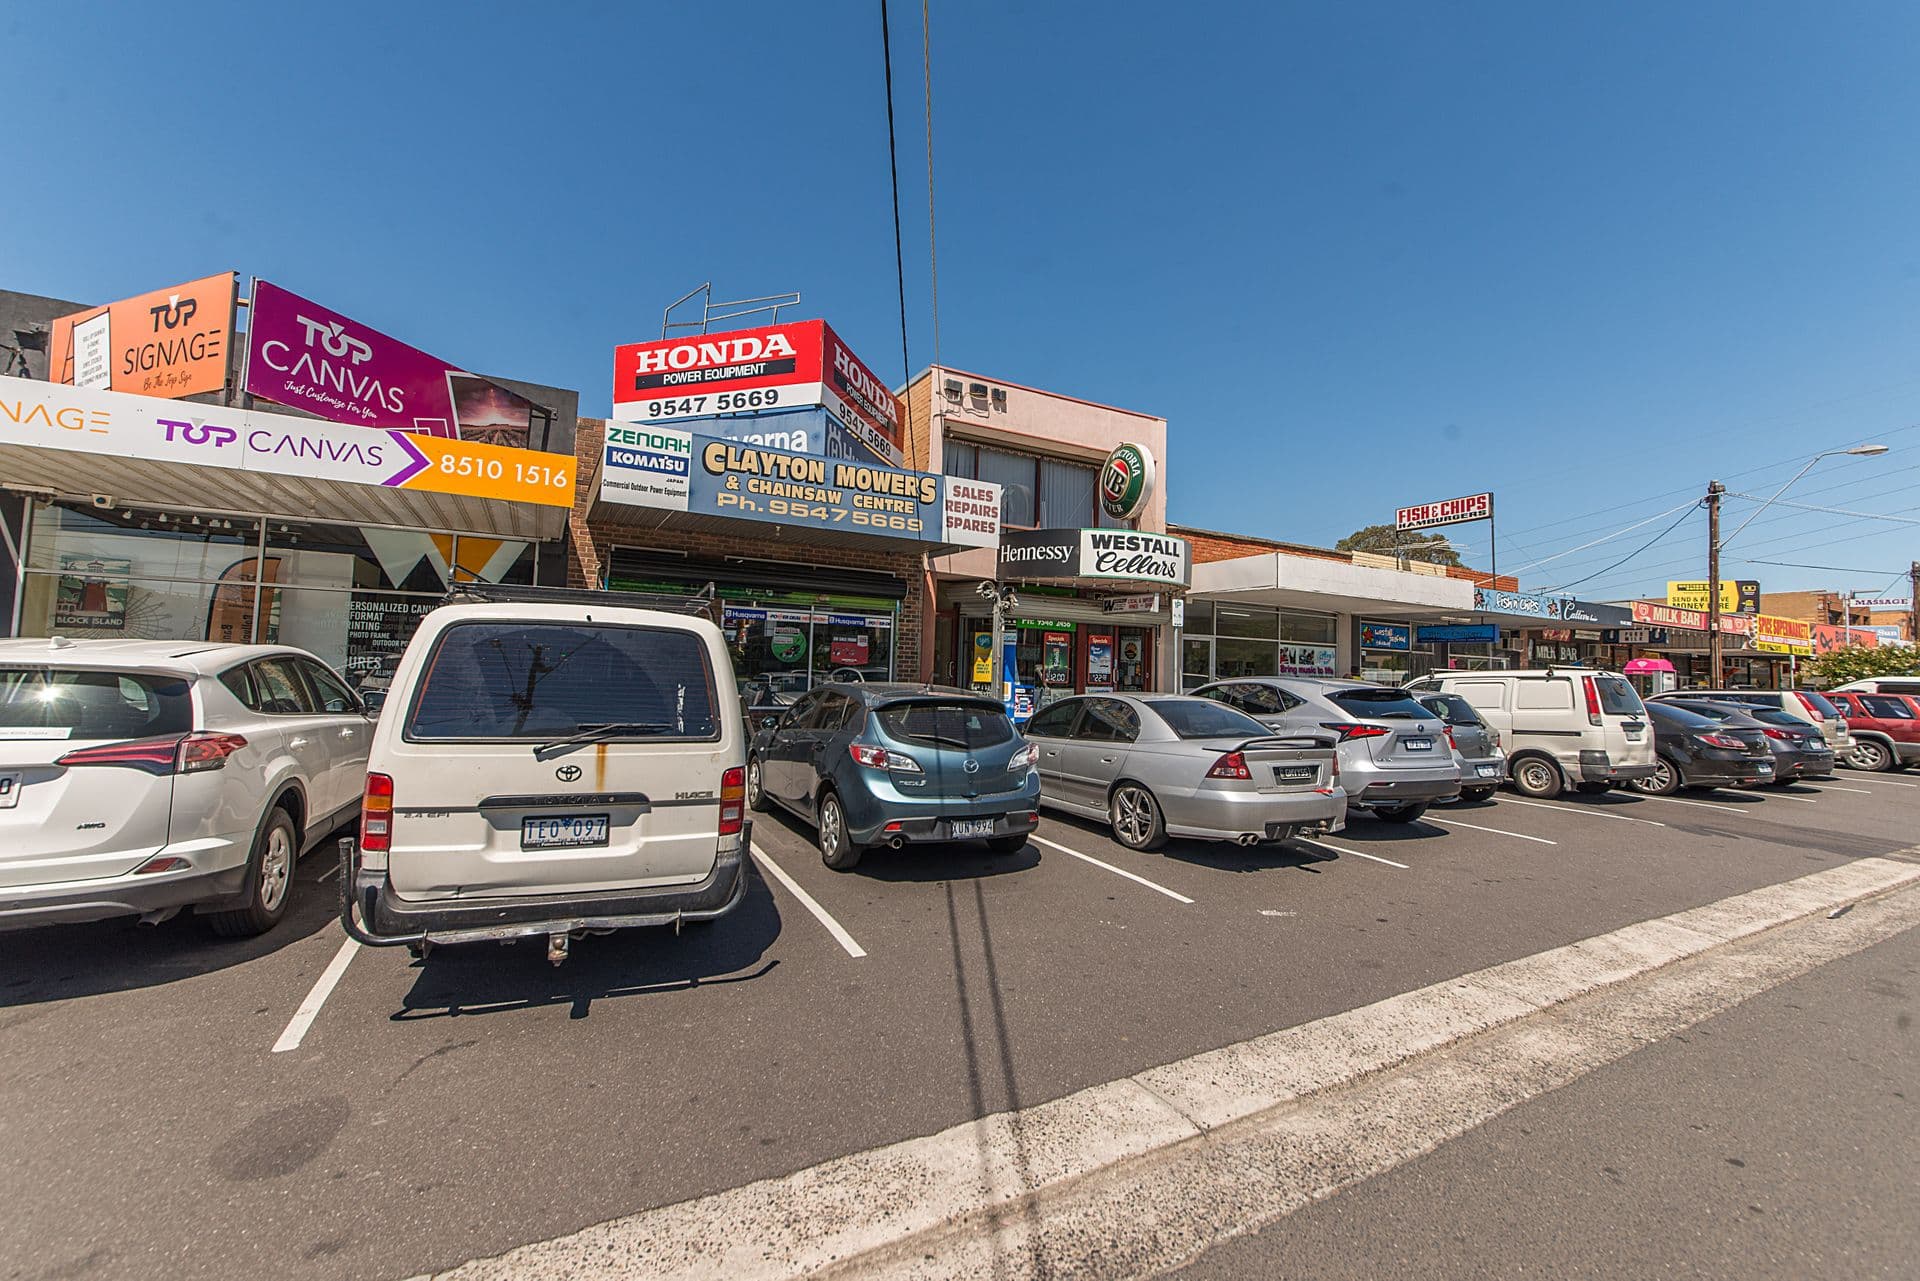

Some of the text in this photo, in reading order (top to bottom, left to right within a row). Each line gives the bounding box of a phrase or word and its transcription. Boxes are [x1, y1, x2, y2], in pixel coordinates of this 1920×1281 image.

[150, 296, 197, 332] TOP
[297, 314, 373, 365] TOP
[124, 330, 220, 375] SIGNAGE
[636, 334, 796, 373] HONDA
[262, 340, 404, 413] CANVAS
[663, 363, 766, 384] POWER EQUIPMENT
[834, 342, 898, 424] HONDA
[284, 381, 377, 418] Just Customize For You
[650, 388, 779, 417] 9547 5669
[846, 383, 888, 428] POWER EQUIPMENT
[840, 402, 864, 436] 9547
[868, 430, 890, 456] 5669
[0, 401, 567, 488] NAGE TOP CANVAS 8510 1516
[608, 428, 690, 454] ZENOAH
[612, 451, 684, 472] KOMATSU
[703, 442, 825, 484] CLAYTON
[835, 464, 936, 504] MOWERS
[603, 479, 687, 498] Commercial Outdoor Power Equipment
[725, 475, 914, 514] & CHAINSAW CENTRE
[953, 486, 994, 502] SALES
[946, 500, 998, 518] REPAIRS
[1398, 496, 1486, 524] FISH & CHIPS
[946, 516, 996, 534] SPARES
[1398, 510, 1486, 528] HAMBURGERS
[1000, 544, 1074, 563] Hennessy
[1091, 534, 1180, 558] WESTALL
[1096, 551, 1176, 578] Cellars
[350, 601, 440, 614] ERSONALIZED CANV
[1672, 602, 1704, 610] MONEY
[1855, 598, 1908, 606] MASSAGE
[56, 616, 123, 626] BLOCK ISLAND
[350, 612, 384, 622] FORMAT
[732, 611, 766, 619] Husqvarna
[836, 617, 864, 626] Husqvarna
[1652, 607, 1700, 626] MILK BAR
[348, 622, 380, 631] RINTING
[1536, 646, 1577, 660] MILK BAR
[1280, 664, 1297, 674] Bring
[1298, 666, 1316, 674] music
[676, 790, 714, 800] HIACE
[76, 822, 106, 830] AWD
[574, 819, 606, 836] 097
[976, 820, 992, 832] 994
